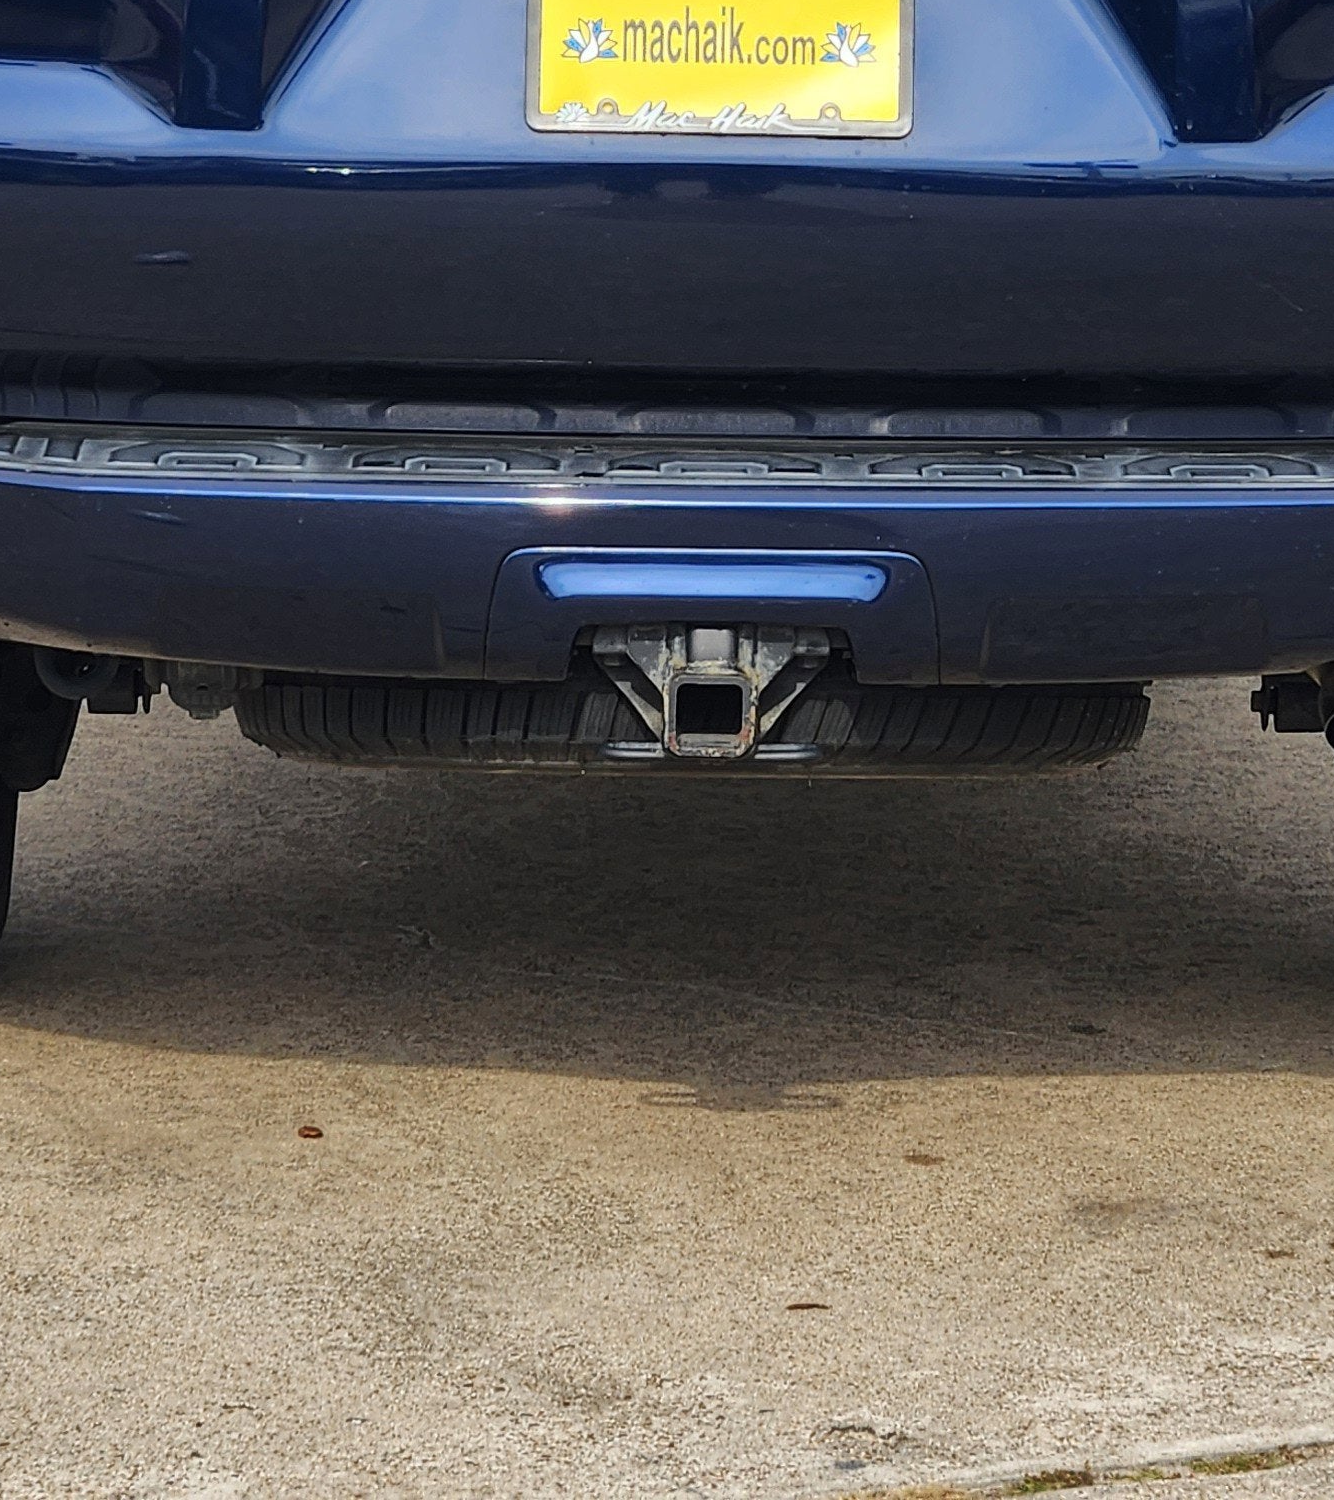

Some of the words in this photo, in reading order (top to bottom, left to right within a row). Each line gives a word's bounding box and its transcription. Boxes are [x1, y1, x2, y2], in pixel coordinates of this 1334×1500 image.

[622, 6, 816, 65] machaik.com
[626, 100, 697, 131] Mac
[707, 102, 795, 132] Haik
